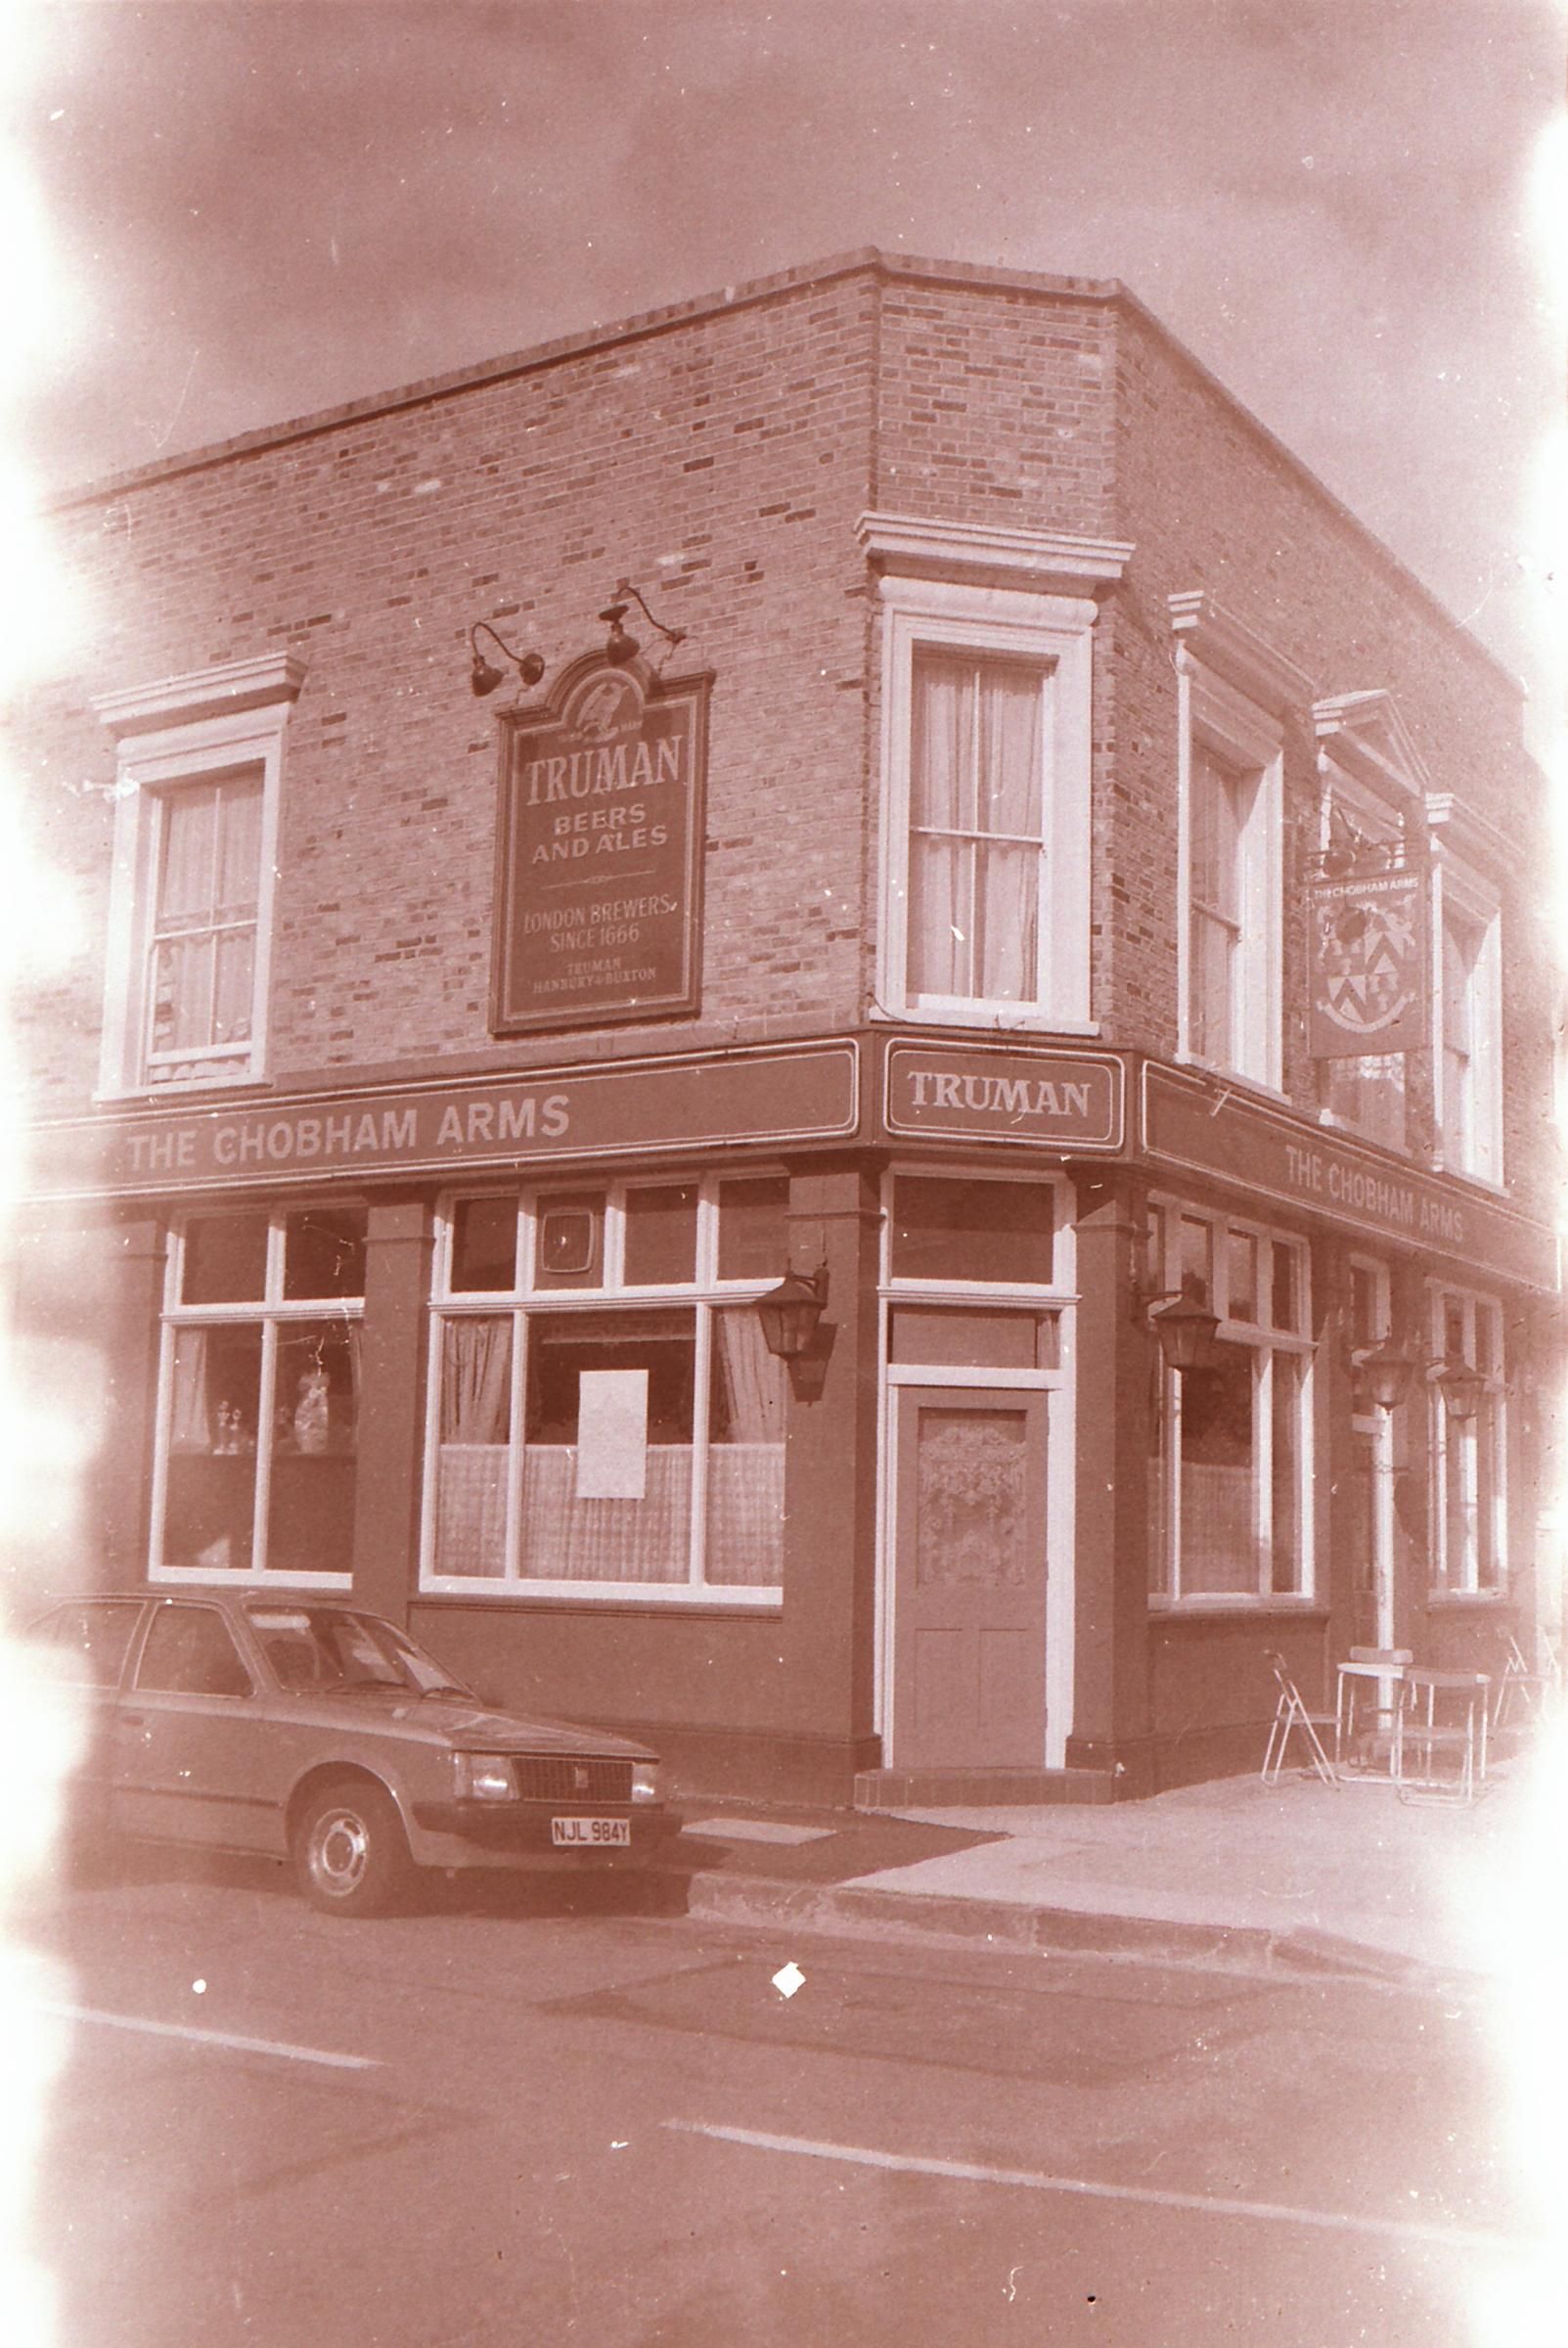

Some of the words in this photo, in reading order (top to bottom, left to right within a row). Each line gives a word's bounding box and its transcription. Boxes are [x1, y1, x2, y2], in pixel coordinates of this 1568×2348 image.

[525, 735, 684, 806] TRUMAN
[554, 803, 647, 835] BEERS
[532, 836, 589, 864] AND
[595, 825, 668, 854] ALES
[523, 907, 586, 934] LONDON
[550, 929, 596, 953] SINCE
[600, 923, 640, 947] 1666
[567, 958, 621, 975] TRUMAN
[908, 1070, 1092, 1117] TRUMAN
[127, 1128, 196, 1172] THE
[213, 1109, 418, 1165] CHOBHAM
[437, 1094, 570, 1146] ARMS
[1285, 1145, 1322, 1191] THE
[1328, 1162, 1414, 1224] CHOBHAM
[1420, 1198, 1464, 1243] ARMS
[554, 1821, 588, 1841] NJL
[592, 1820, 628, 1842] 984Y
